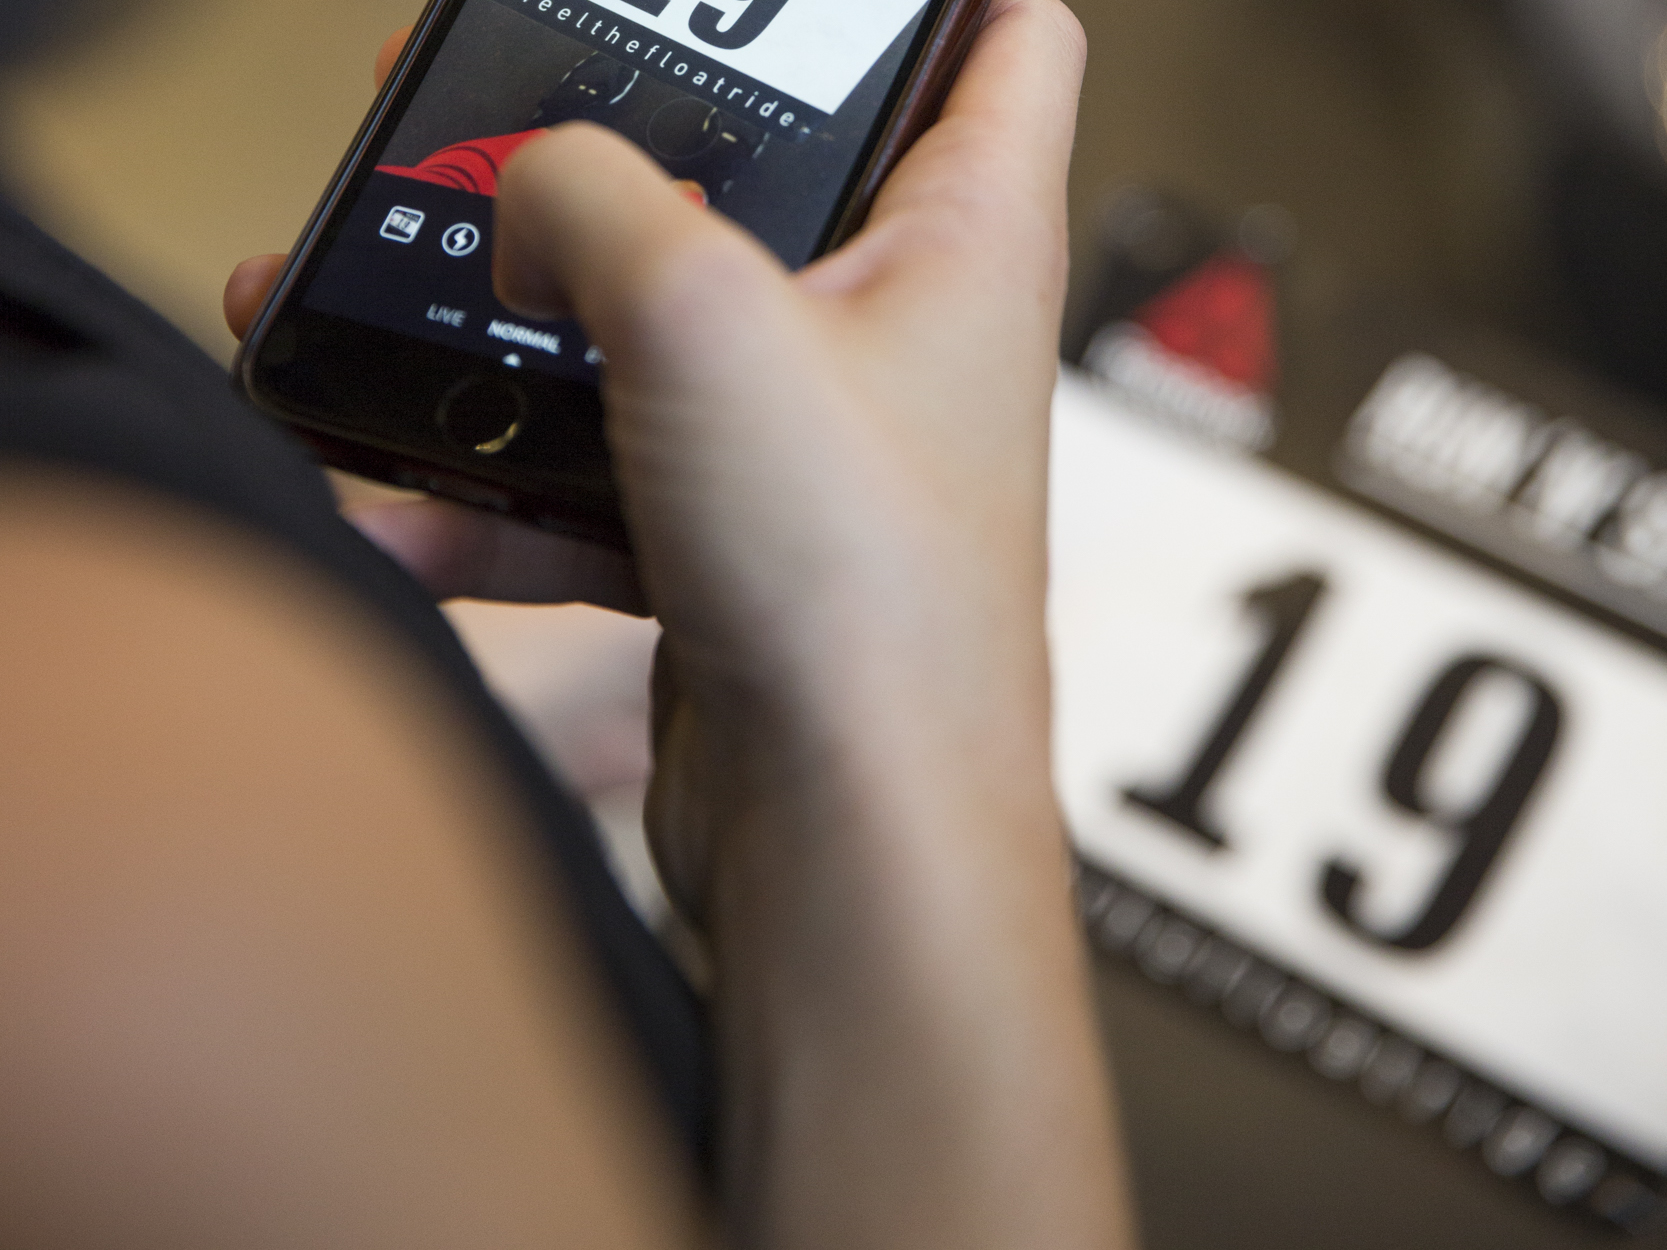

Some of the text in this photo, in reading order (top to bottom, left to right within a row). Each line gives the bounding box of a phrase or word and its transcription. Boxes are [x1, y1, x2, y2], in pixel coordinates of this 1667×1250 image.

[426, 303, 467, 327] LIVE
[487, 319, 562, 355] NORMAL
[1120, 565, 1570, 957] 19
